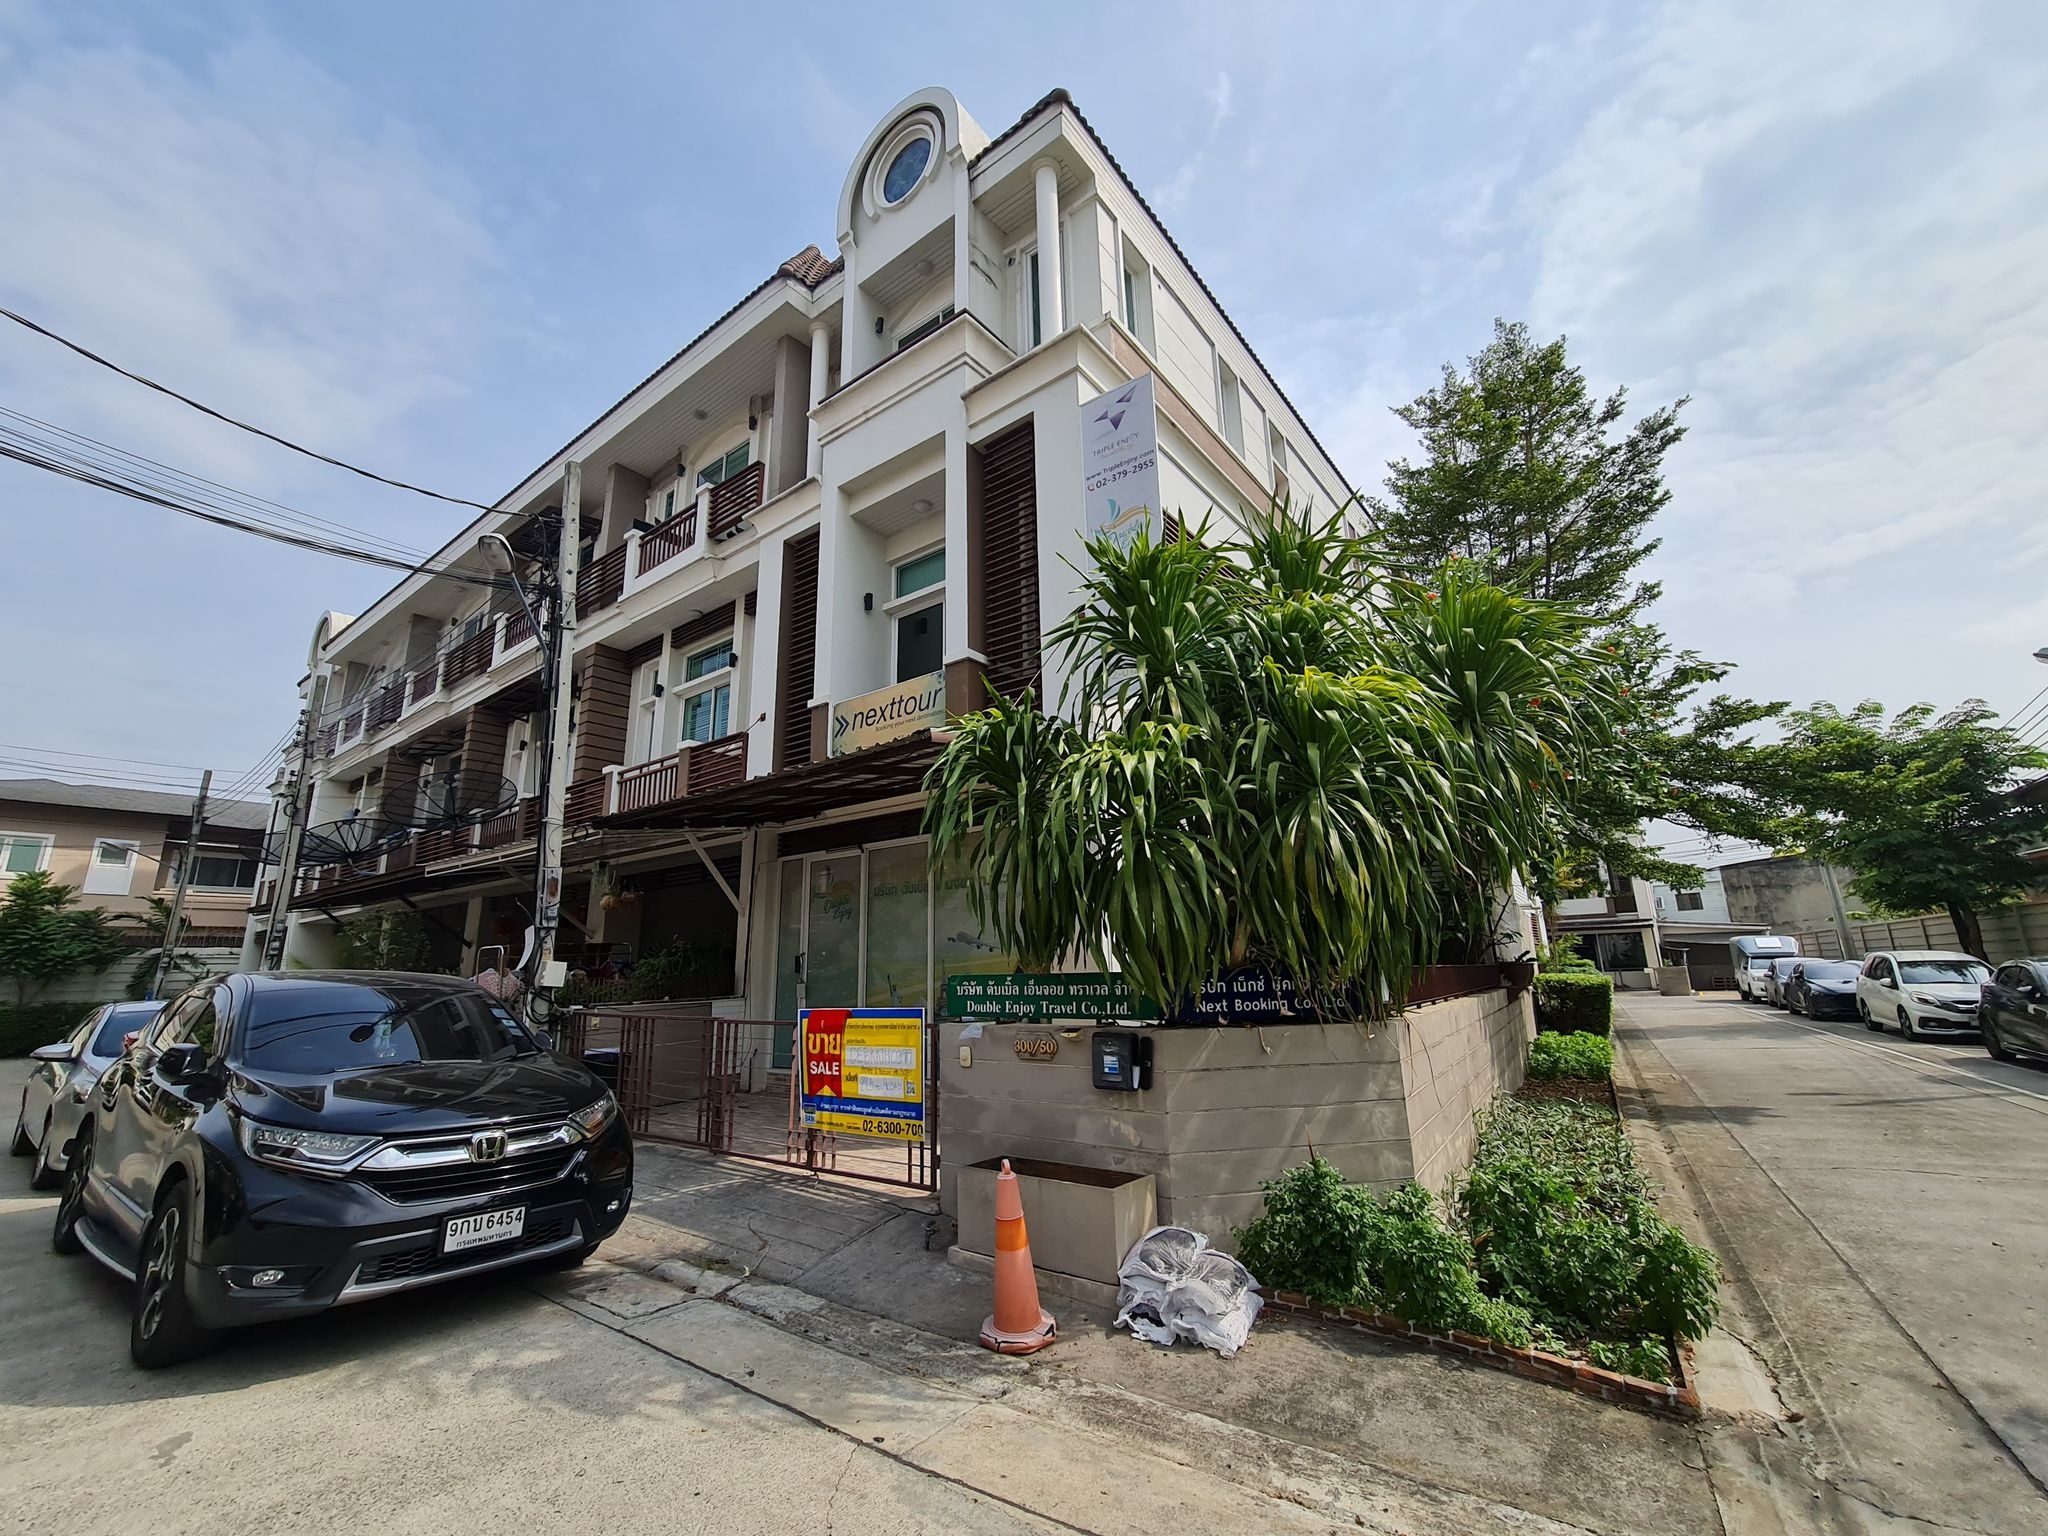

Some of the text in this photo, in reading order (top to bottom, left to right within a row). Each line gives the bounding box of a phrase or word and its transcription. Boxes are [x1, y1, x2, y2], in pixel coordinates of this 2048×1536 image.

[1092, 441, 1116, 457] TRIPLE
[1116, 431, 1139, 447] ENJOY
[1095, 458, 1154, 489] 02-379-2955
[851, 687, 943, 732] nexttour
[894, 719, 905, 729] your
[905, 716, 916, 725] next
[956, 980, 983, 996] บริษัท
[987, 976, 1020, 996] ดับเบิ้ล
[1024, 979, 1065, 996] เอ็นจอย
[1069, 982, 1109, 996] ทราเวล
[966, 1000, 1132, 1017] Double Enjoy Travel Co.,Ltd.
[1196, 999, 1228, 1013] Next
[1234, 997, 1288, 1014] Booking
[808, 1032, 841, 1055] ขาย
[1014, 1039, 1054, 1055] 300/50
[810, 1060, 840, 1076] SALE
[449, 1208, 523, 1237] 9กบ 6454
